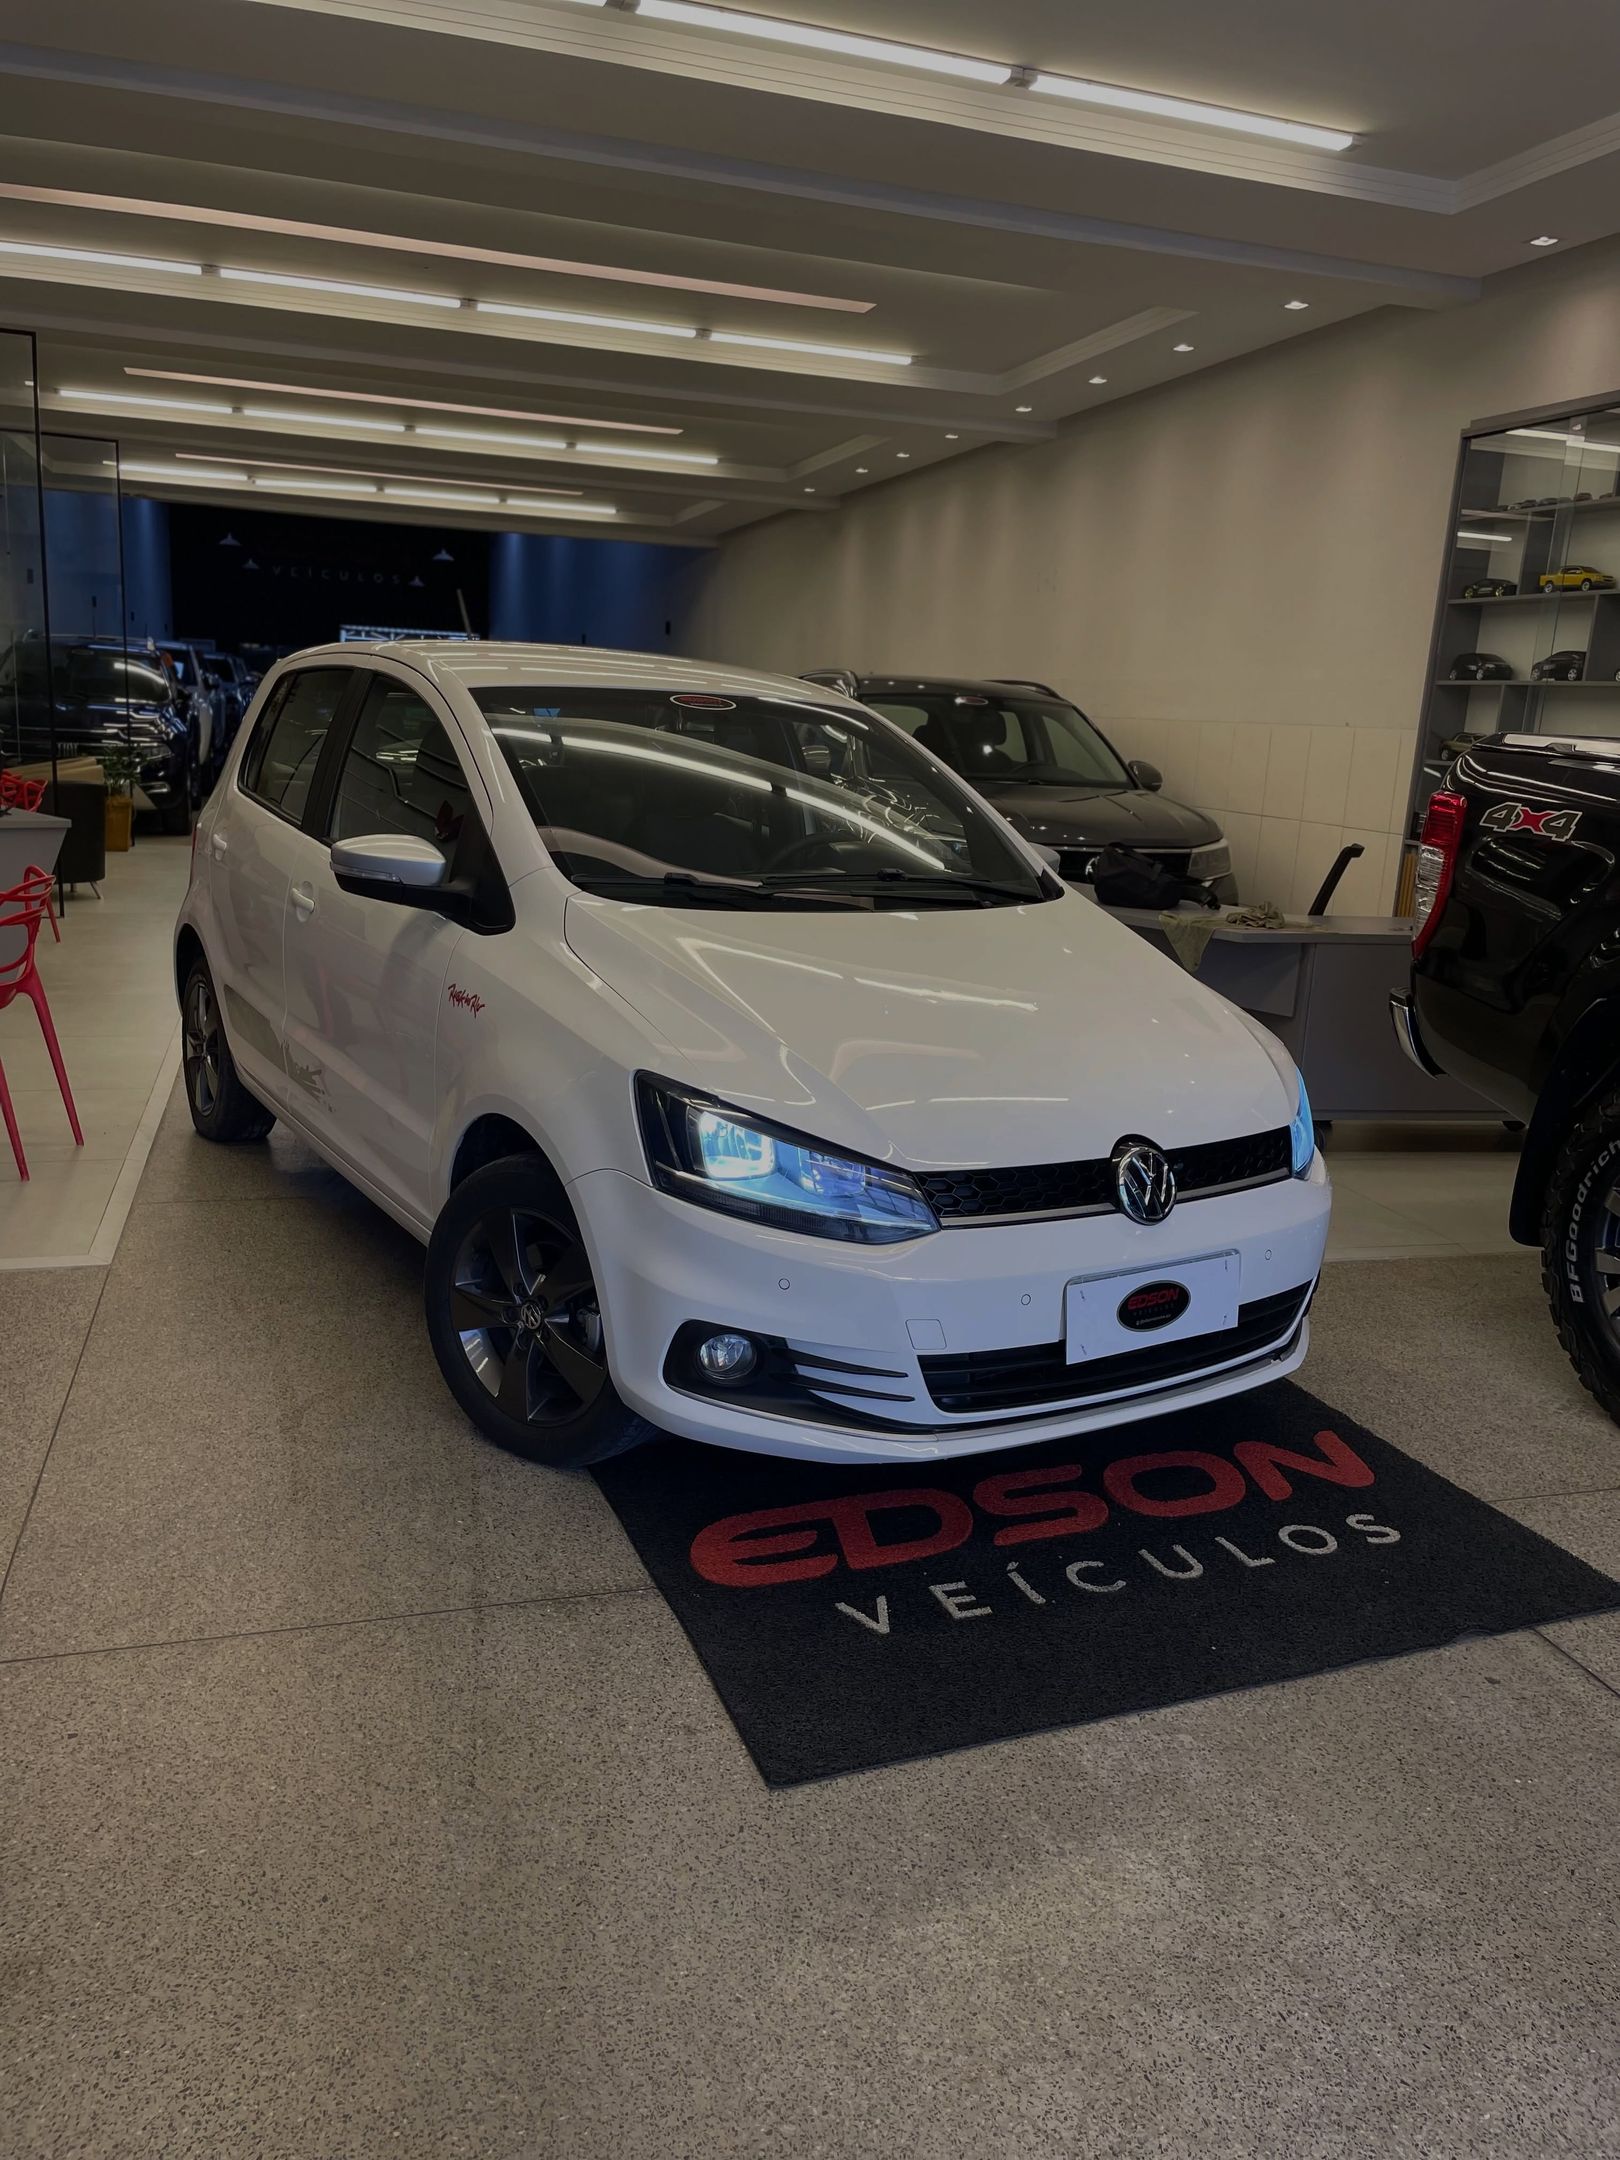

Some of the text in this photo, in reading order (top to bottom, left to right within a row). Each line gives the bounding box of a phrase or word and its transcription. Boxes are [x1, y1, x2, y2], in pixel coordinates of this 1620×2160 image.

[1565, 1139, 1620, 1304] BFGoodrich
[1127, 1286, 1180, 1311] EDSON
[690, 1430, 1374, 1587] EDSON
[834, 1513, 1401, 1635] VEÍCULOS
